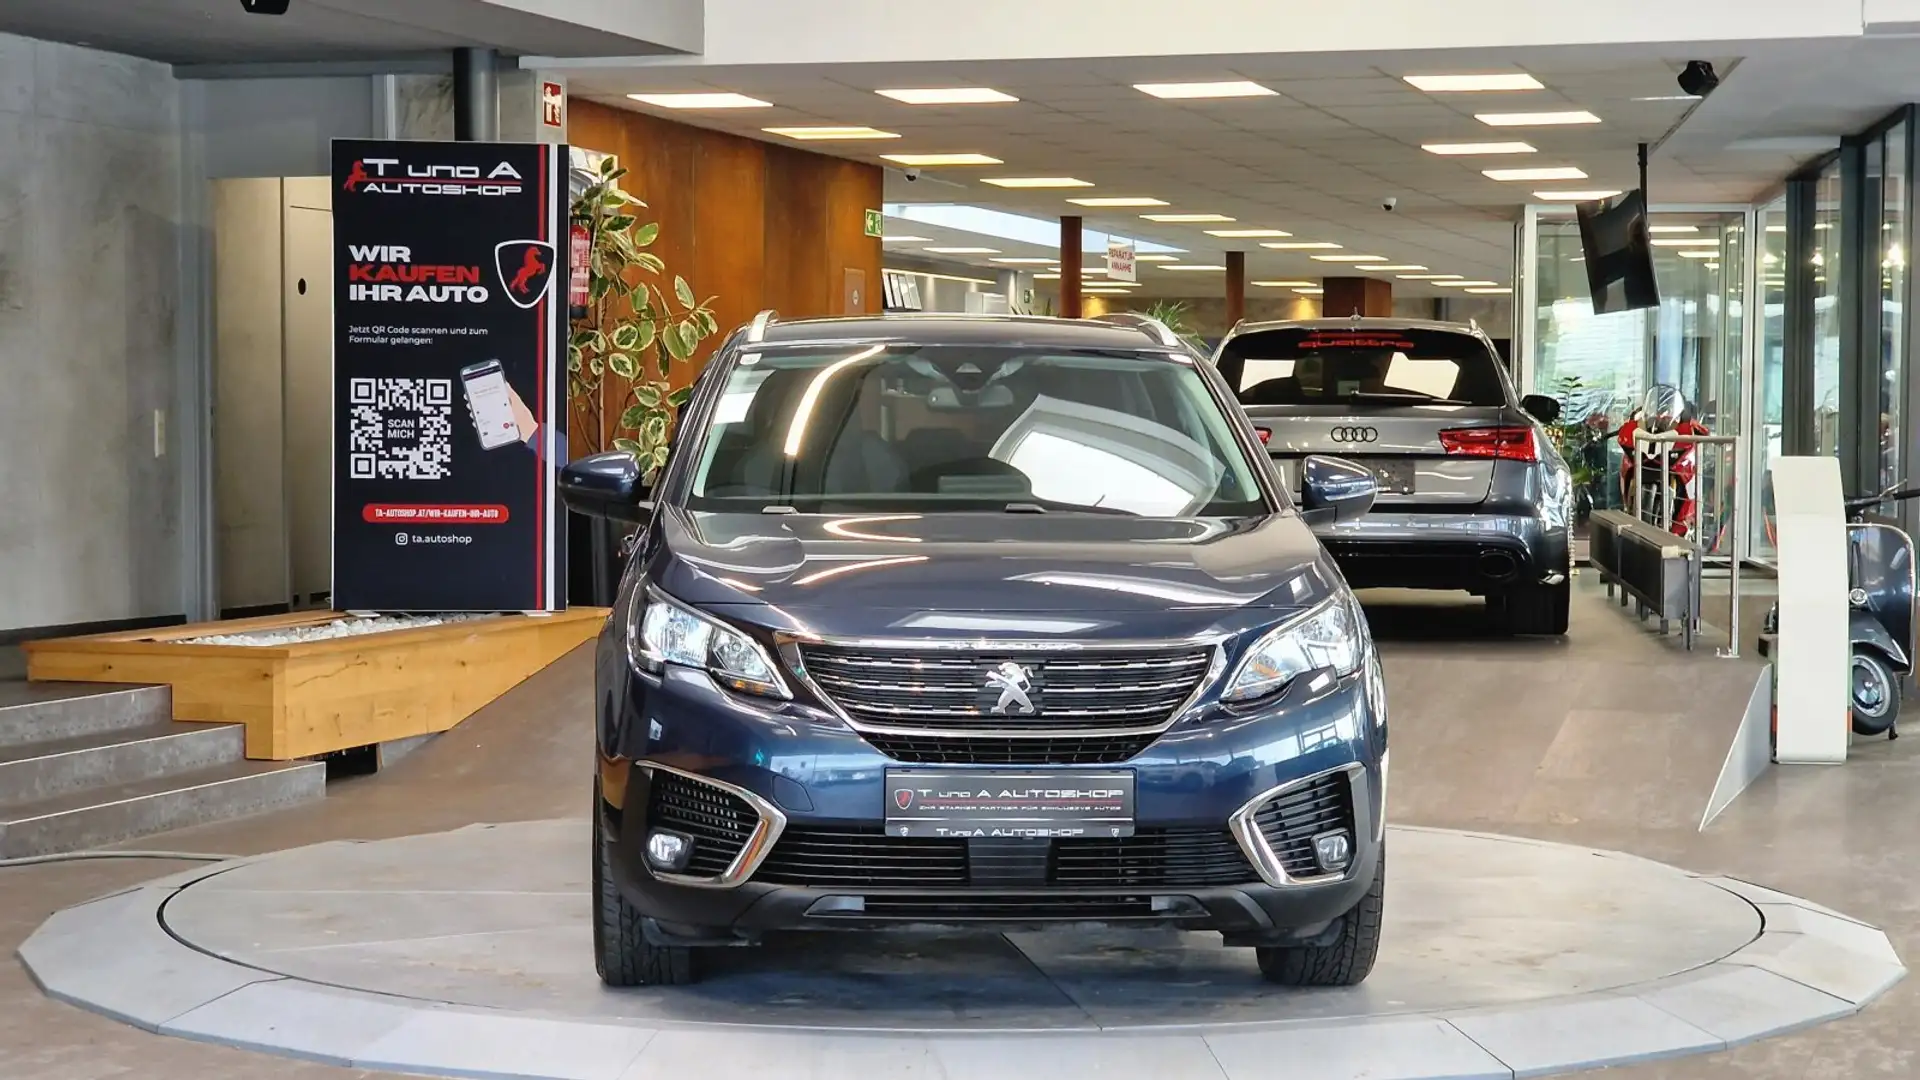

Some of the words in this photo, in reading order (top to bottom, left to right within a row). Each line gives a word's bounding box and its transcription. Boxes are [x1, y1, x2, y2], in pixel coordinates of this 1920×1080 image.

[363, 158, 399, 176] T
[487, 160, 522, 180] A
[363, 182, 523, 196] AUTOSHOP
[348, 245, 411, 263] WIR
[349, 264, 480, 284] KAUFEN
[349, 284, 403, 302] IHR
[405, 286, 490, 304] AUTO
[348, 325, 370, 334] Jetzt
[371, 325, 386, 335] QR
[387, 325, 410, 334] Code
[411, 326, 448, 335] scannen
[450, 326, 467, 335] und
[469, 328, 489, 336] zum
[349, 335, 389, 344] Formular
[390, 336, 433, 346] gelangen:
[387, 418, 415, 429] SCAN
[387, 429, 415, 439] MICH
[412, 534, 473, 545] ta.autoshop
[917, 788, 933, 798] T
[976, 789, 992, 798] A
[998, 788, 1124, 799] AUTOSHOP
[991, 827, 1084, 837] AUTOSHOP
